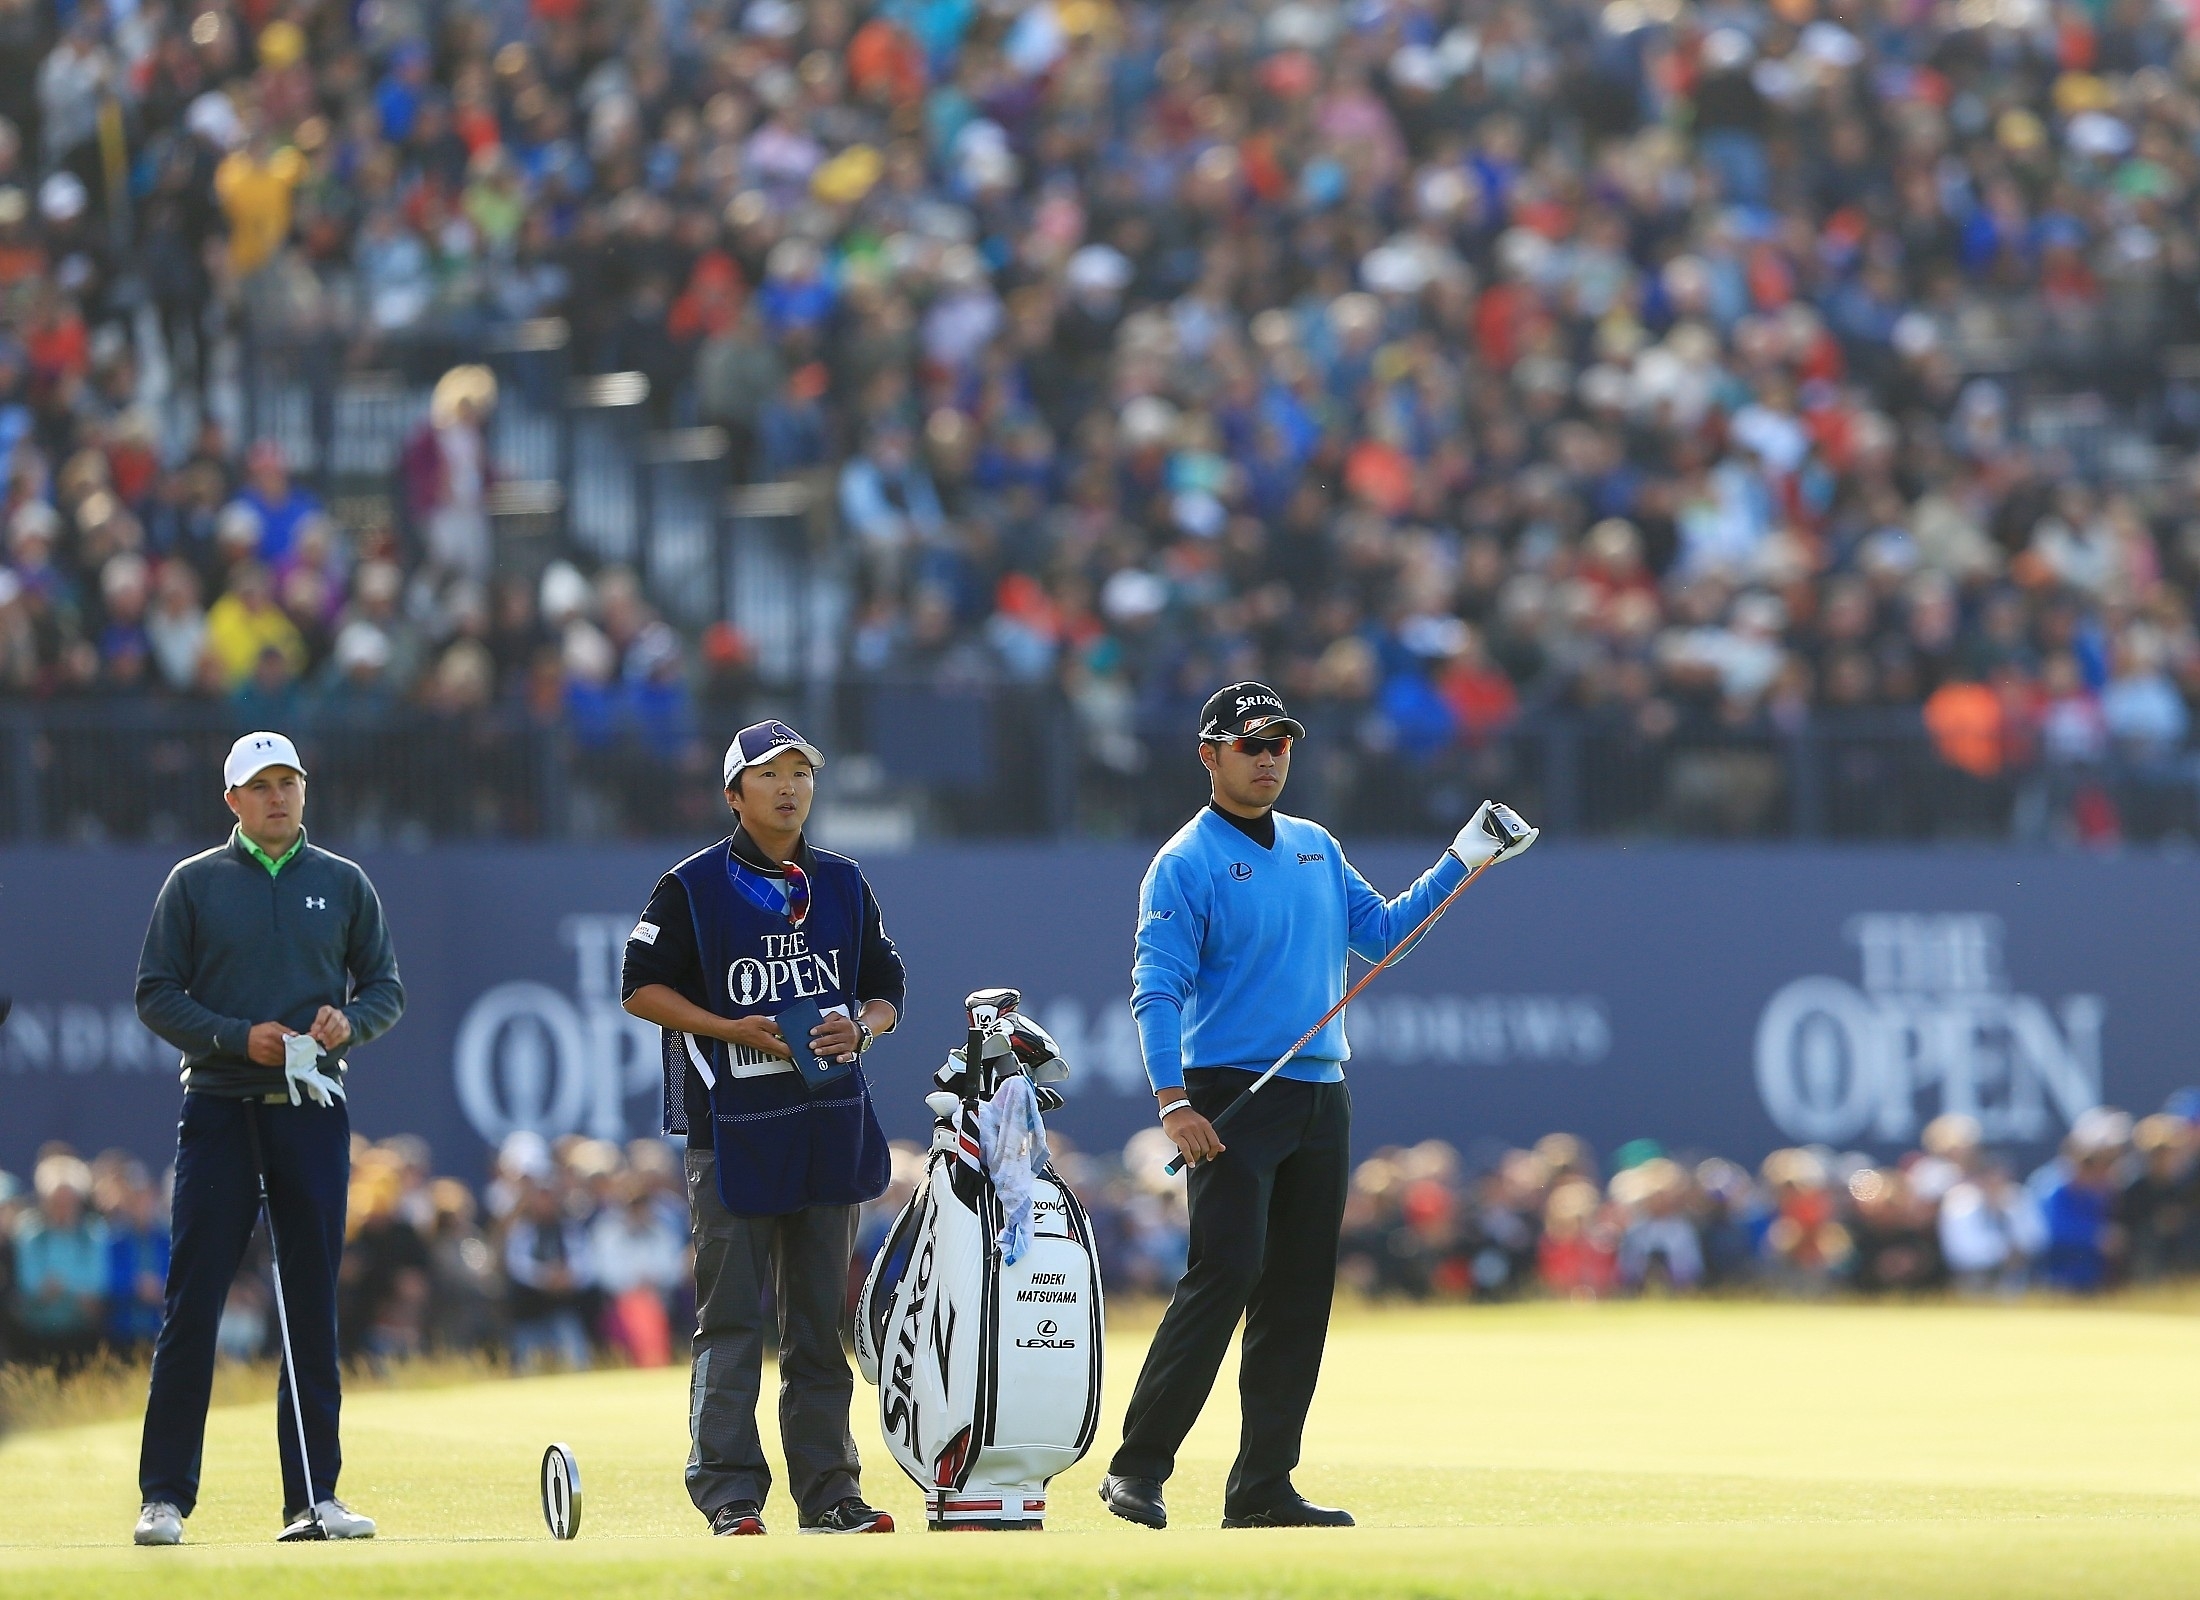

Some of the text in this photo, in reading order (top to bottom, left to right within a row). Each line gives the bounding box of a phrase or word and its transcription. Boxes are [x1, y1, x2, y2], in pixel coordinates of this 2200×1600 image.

[1235, 694, 1285, 717] SRIXON
[1297, 853, 1325, 865] SRIXON
[761, 932, 809, 958] THE
[727, 949, 841, 1006] OPEN
[1754, 974, 2106, 1146] OPEN
[1031, 1273, 1066, 1286] HIDEKI
[1016, 1290, 1077, 1304] MATSUYAMA
[1015, 1338, 1076, 1349] LEXUS
